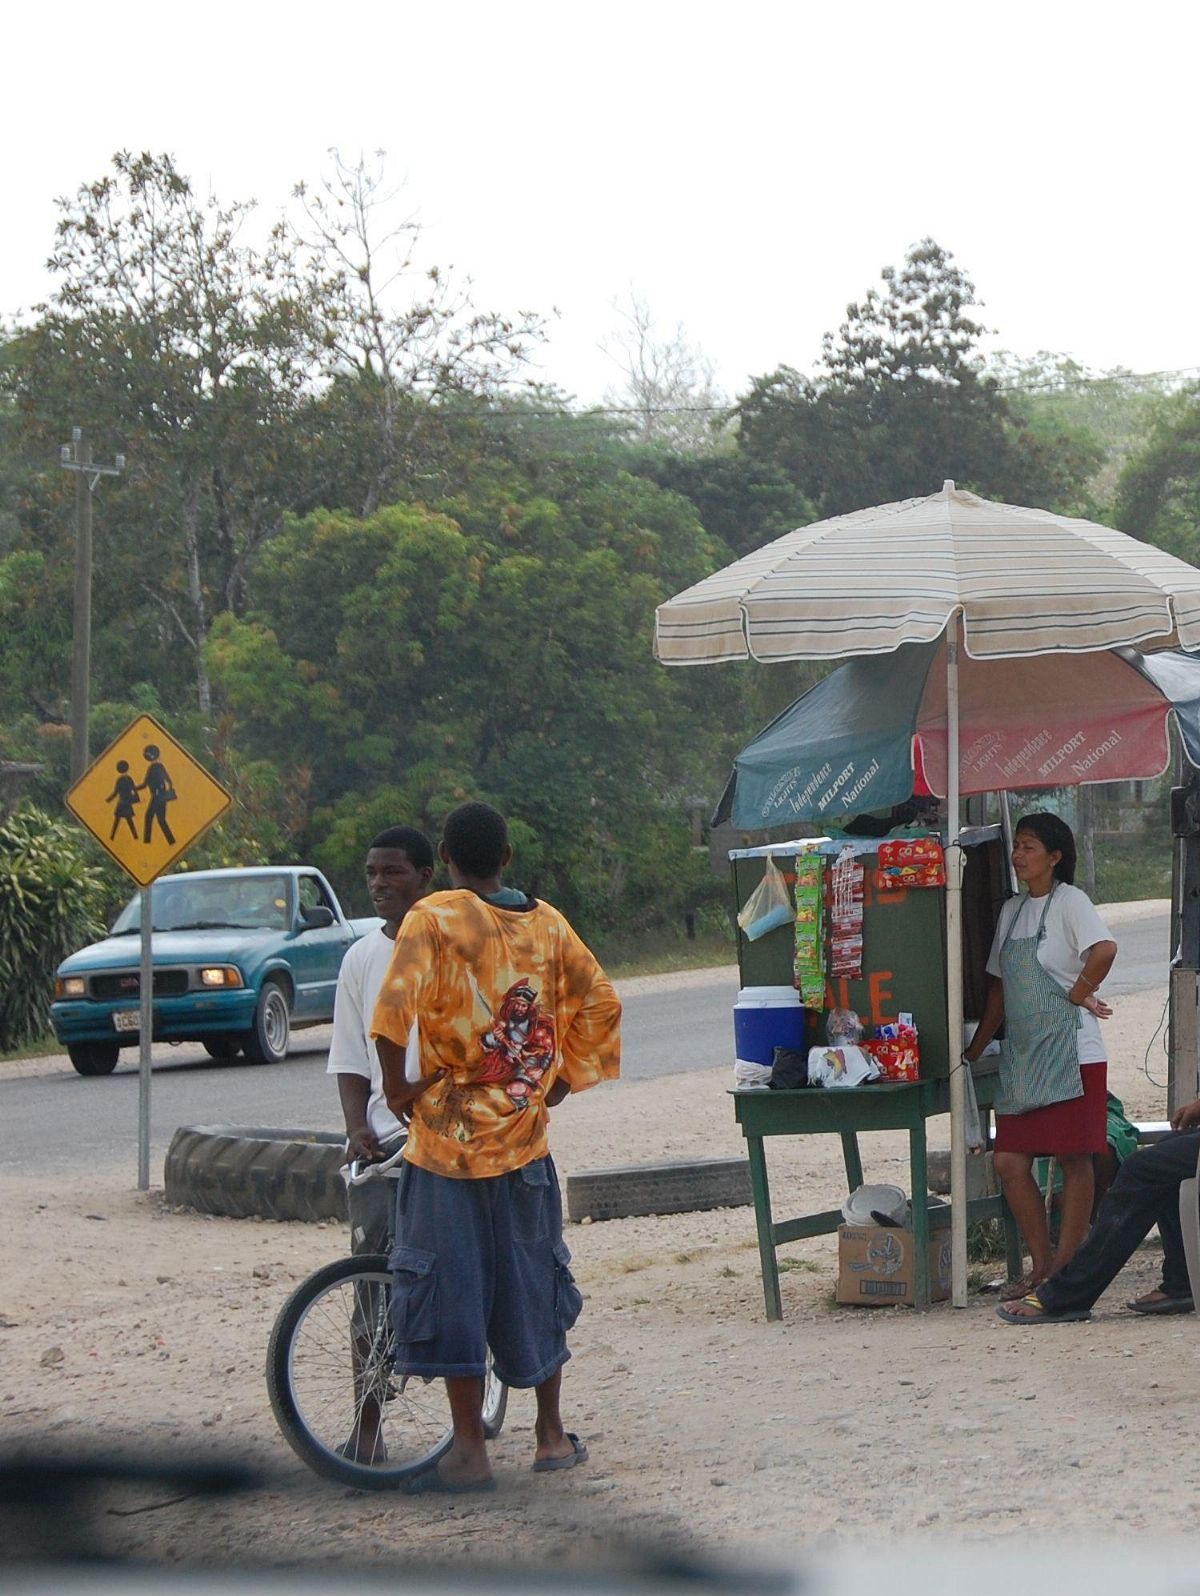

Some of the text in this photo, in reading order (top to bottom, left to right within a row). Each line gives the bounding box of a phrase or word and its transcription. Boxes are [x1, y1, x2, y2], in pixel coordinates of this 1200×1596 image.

[994, 727, 1054, 780] Independence
[1037, 731, 1088, 777] MILPORT
[1070, 729, 1123, 777] National
[788, 761, 833, 814] Independence
[817, 761, 857, 812] MILPORT
[841, 757, 881, 809] National
